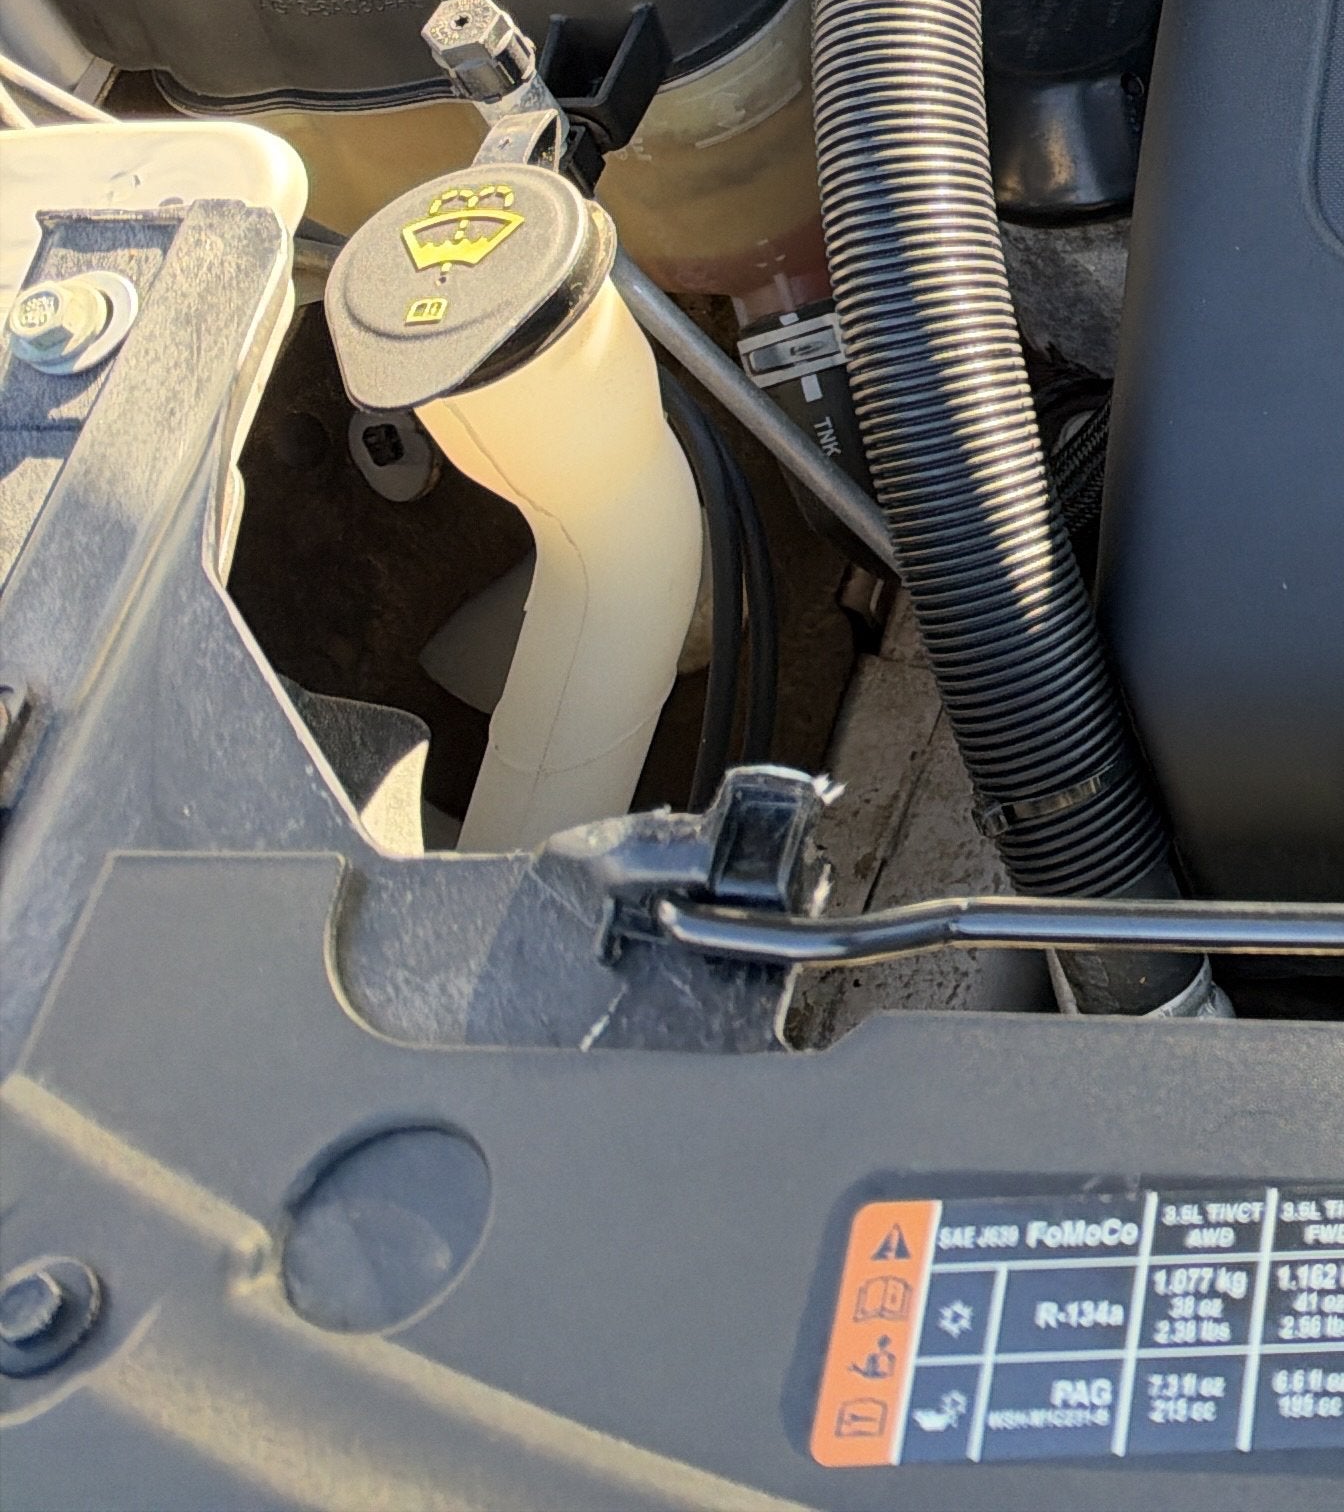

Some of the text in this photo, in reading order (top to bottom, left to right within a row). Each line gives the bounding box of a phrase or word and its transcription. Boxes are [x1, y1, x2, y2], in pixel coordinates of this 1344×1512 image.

[813, 415, 842, 458] TNK
[938, 1224, 976, 1250] SAE
[1025, 1217, 1139, 1249] FoMoCo
[1184, 1227, 1235, 1249] AWD
[1152, 1266, 1248, 1299] 1.077 kg
[1034, 1299, 1125, 1329] R-134a
[1197, 1297, 1224, 1318] oz
[1292, 1290, 1318, 1313] 41
[1199, 1318, 1231, 1342] lbs
[1050, 1377, 1113, 1408] PAG
[1199, 1376, 1226, 1398] oz
